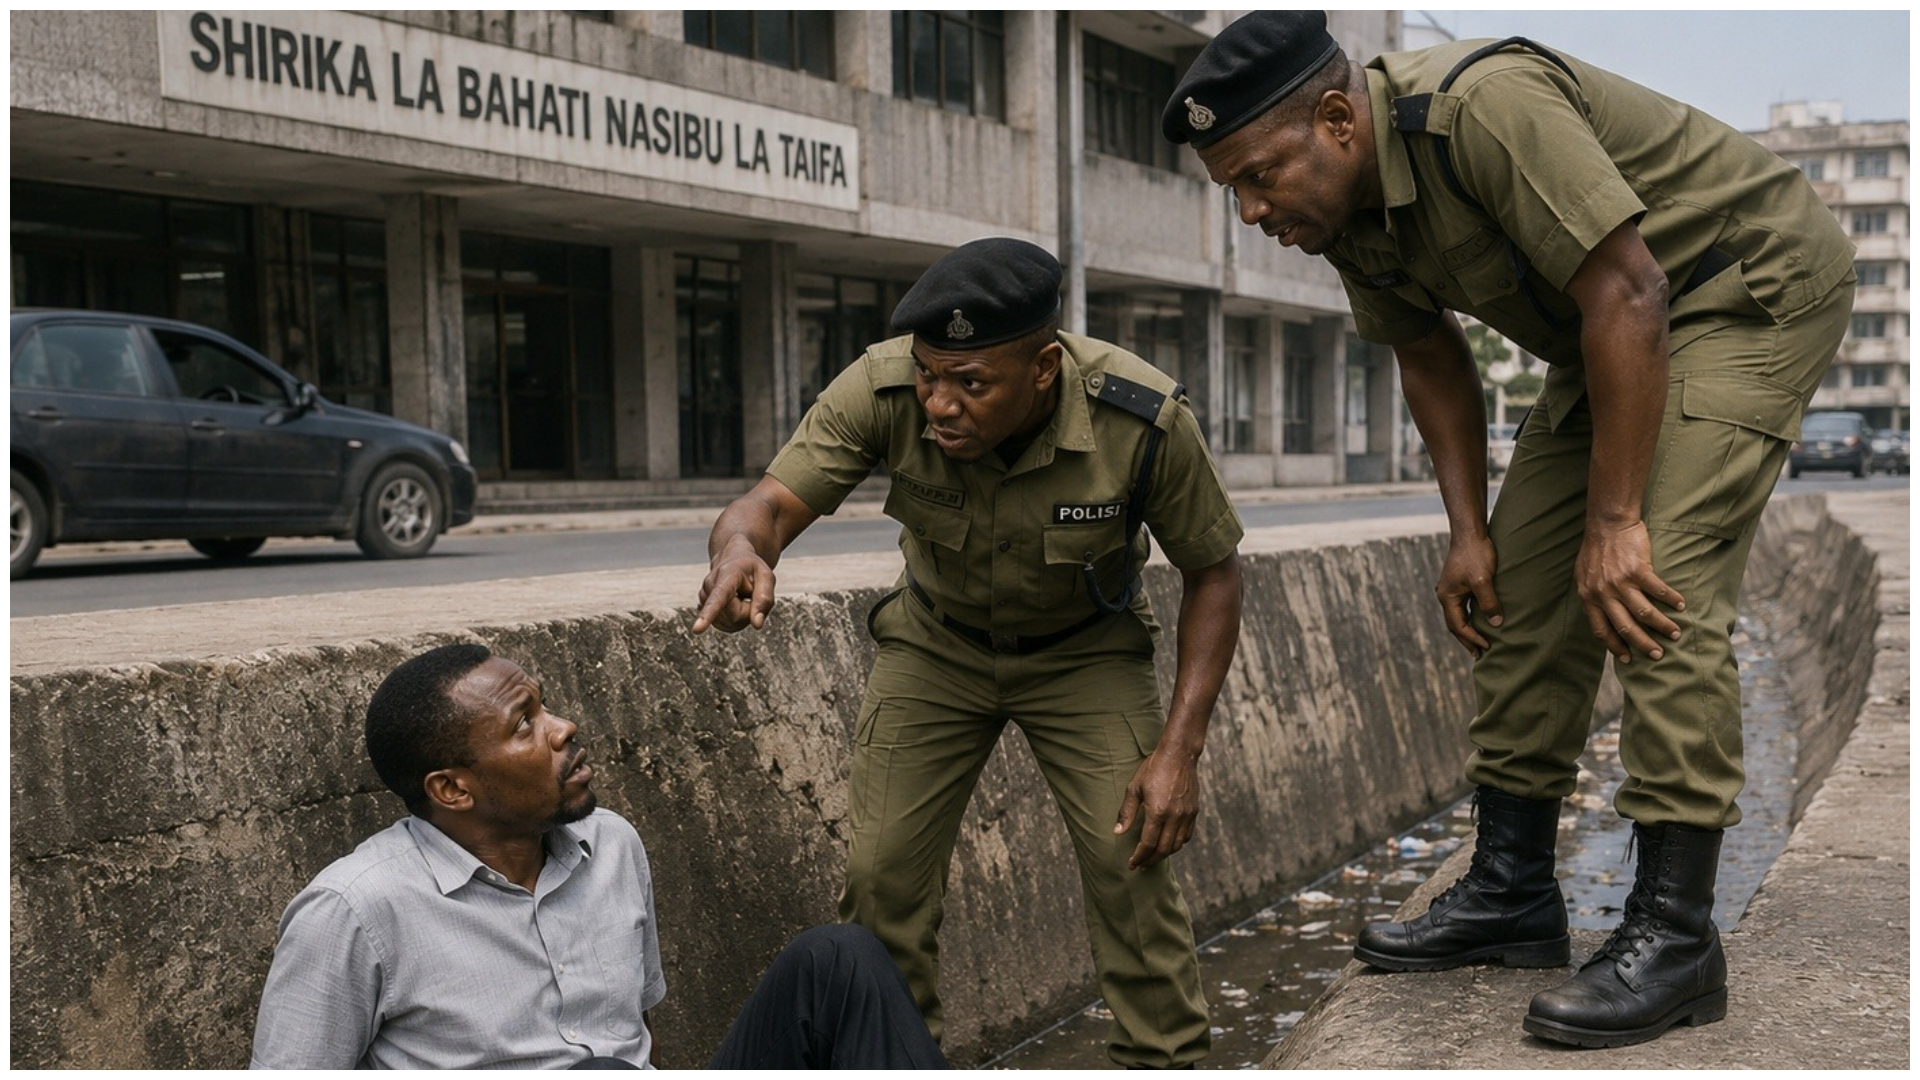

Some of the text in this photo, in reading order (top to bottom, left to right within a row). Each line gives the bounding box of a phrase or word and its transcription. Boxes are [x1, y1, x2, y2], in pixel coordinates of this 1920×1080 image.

[190, 11, 848, 188] SHIRIKA LA BAHATI NASIBU LA TAIFA
[1059, 505, 1121, 521] POLISI
